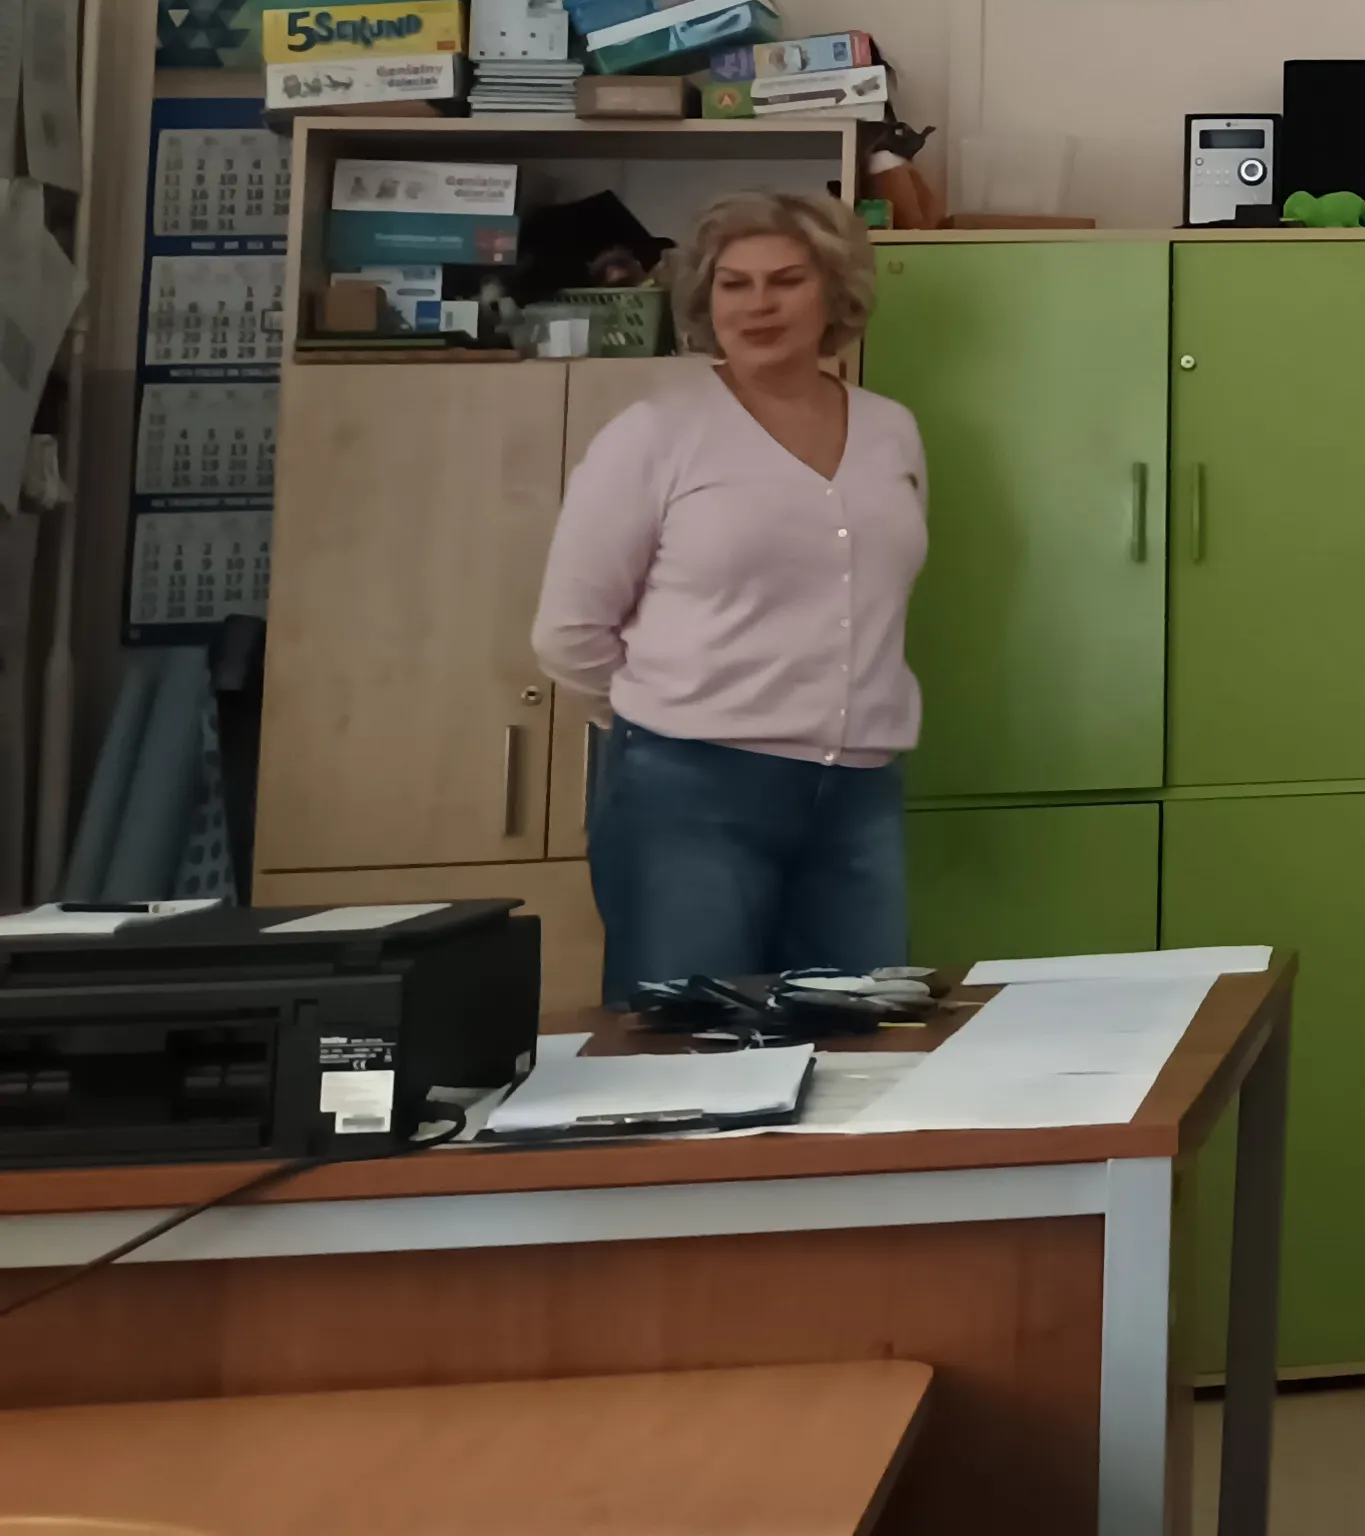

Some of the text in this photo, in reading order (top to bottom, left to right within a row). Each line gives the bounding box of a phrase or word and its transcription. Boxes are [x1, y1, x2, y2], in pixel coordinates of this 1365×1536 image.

[287, 11, 424, 52] 5 SEKUND
[376, 64, 443, 77] Genialny
[218, 301, 226, 312] 7
[211, 331, 228, 343] 21
[182, 346, 199, 359] 27
[175, 544, 183, 555] 1
